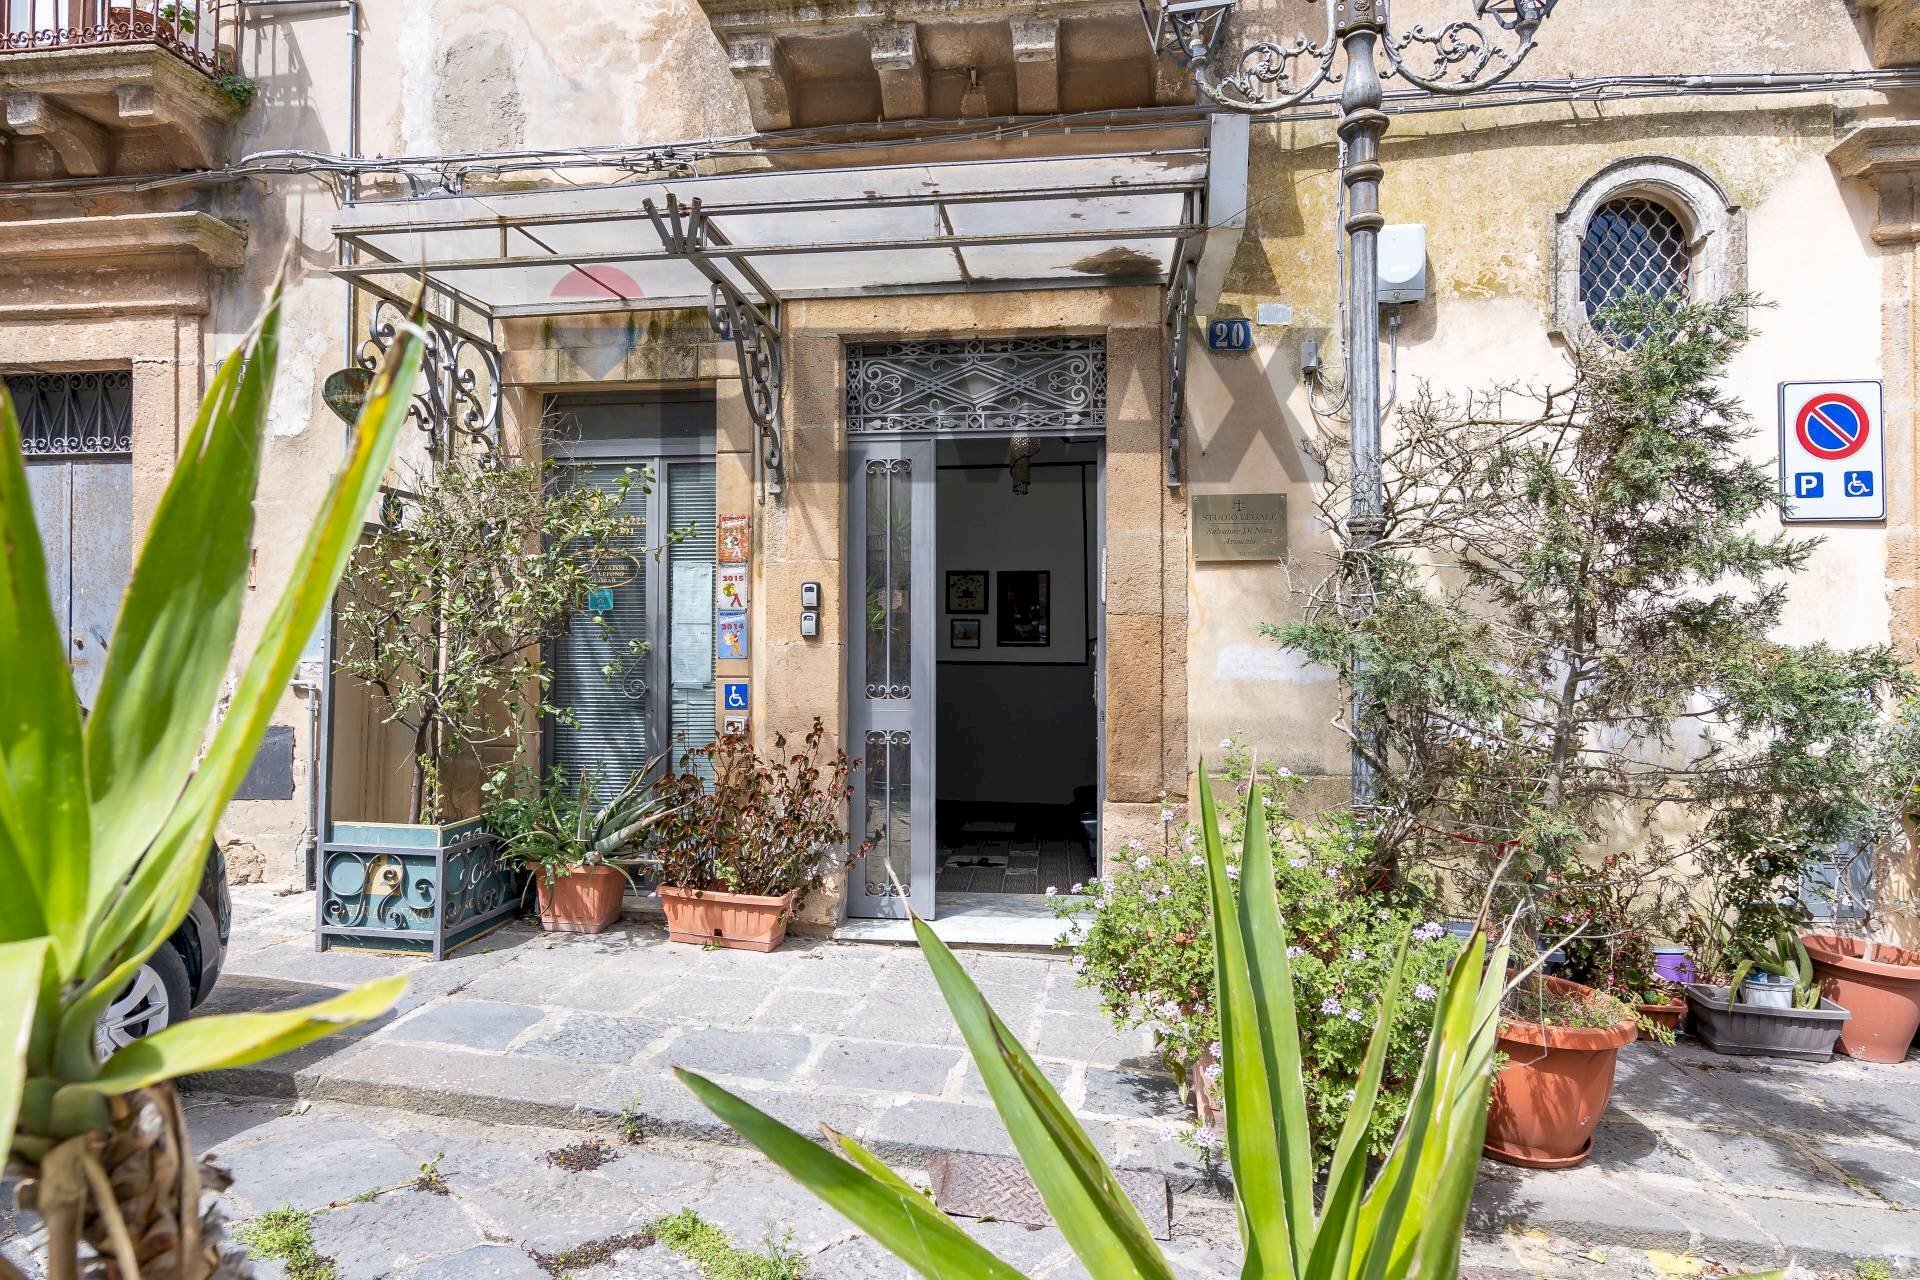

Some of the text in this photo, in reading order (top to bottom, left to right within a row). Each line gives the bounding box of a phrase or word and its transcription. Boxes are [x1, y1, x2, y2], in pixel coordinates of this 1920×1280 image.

[1215, 323, 1245, 347] 20
[1800, 475, 1818, 496] P
[1202, 512, 1277, 521] STUDIO LEGALE
[1207, 527, 1240, 535] Salvatore
[1224, 537, 1256, 545] Avvocato
